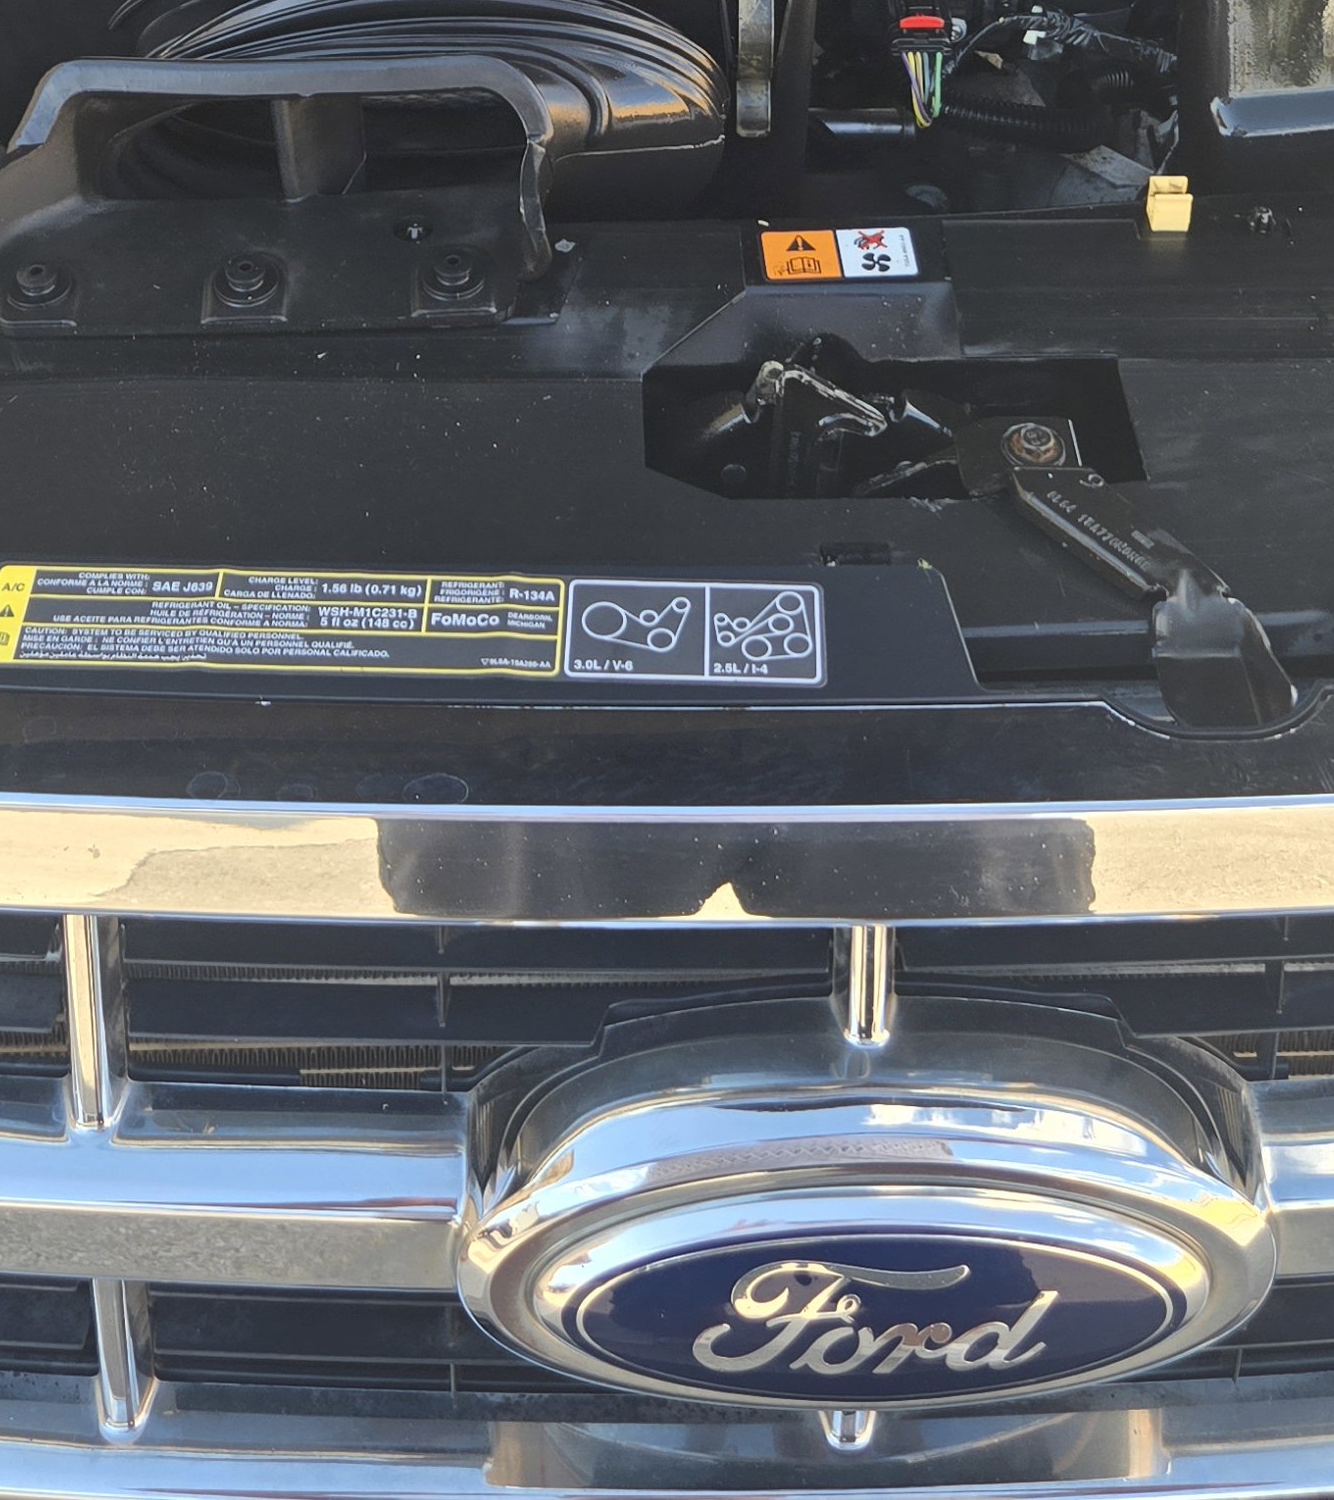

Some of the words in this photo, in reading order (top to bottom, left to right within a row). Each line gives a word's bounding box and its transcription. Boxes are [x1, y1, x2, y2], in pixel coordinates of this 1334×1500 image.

[79, 572, 123, 580] COMPLIES
[125, 573, 150, 581] WITH:
[248, 576, 286, 584] CHARGE
[288, 577, 318, 585] LEVEL:
[2, 583, 25, 592] A/C
[37, 578, 86, 586] CONFORME
[98, 579, 110, 587] LA
[111, 580, 143, 588] NORME
[152, 581, 180, 592] SAE
[183, 581, 213, 592] J639
[274, 584, 312, 592] CHARGE
[86, 587, 122, 595] CUMPLE
[224, 589, 255, 598] CARGA
[257, 590, 269, 598] DE
[271, 591, 316, 599] LLENADO:
[321, 582, 347, 594] 1.56
[349, 583, 363, 594] lb
[365, 583, 396, 596] (0.71
[400, 585, 422, 597] kg)
[509, 588, 556, 602] R-134A
[152, 601, 214, 609] REFRIGERANT
[241, 603, 311, 612] SPECIFICATION:
[150, 609, 175, 617] HUILE
[272, 612, 303, 621] NORME
[318, 606, 417, 619] WSH-M1C231-B
[73, 615, 106, 623] ACEITE
[107, 616, 132, 624] PARA
[134, 616, 208, 626] REFRIGERANTES
[210, 618, 260, 627] CONFORME
[272, 619, 308, 628] NORMA:
[320, 617, 328, 627] 5
[331, 617, 340, 627] fl
[343, 619, 359, 627] oz
[361, 617, 389, 629] (148
[392, 618, 415, 629] cc)
[430, 612, 500, 626] FoMoCo
[507, 619, 545, 629] MICHIGAN
[25, 626, 67, 634] CAUTION:
[110, 628, 122, 636] TO
[139, 629, 183, 637] SERVICED
[185, 630, 197, 638] BY
[199, 630, 246, 639] QUALIFIED
[117, 637, 157, 645] CONFIER
[158, 637, 214, 645] L'ENTRETIEN
[240, 639, 253, 647] UN
[255, 639, 309, 648] PERSONNEL
[100, 643, 139, 651] SISTEMA
[141, 644, 166, 652] DEBE
[168, 644, 186, 652] SER
[188, 645, 233, 654] ATENDIDO
[235, 646, 260, 655] SOLO
[262, 647, 280, 655] POR
[282, 648, 331, 656] PERSONAL
[574, 659, 601, 670] 3.0L
[612, 660, 633, 671] V-6
[692, 1260, 1058, 1375] Ford
